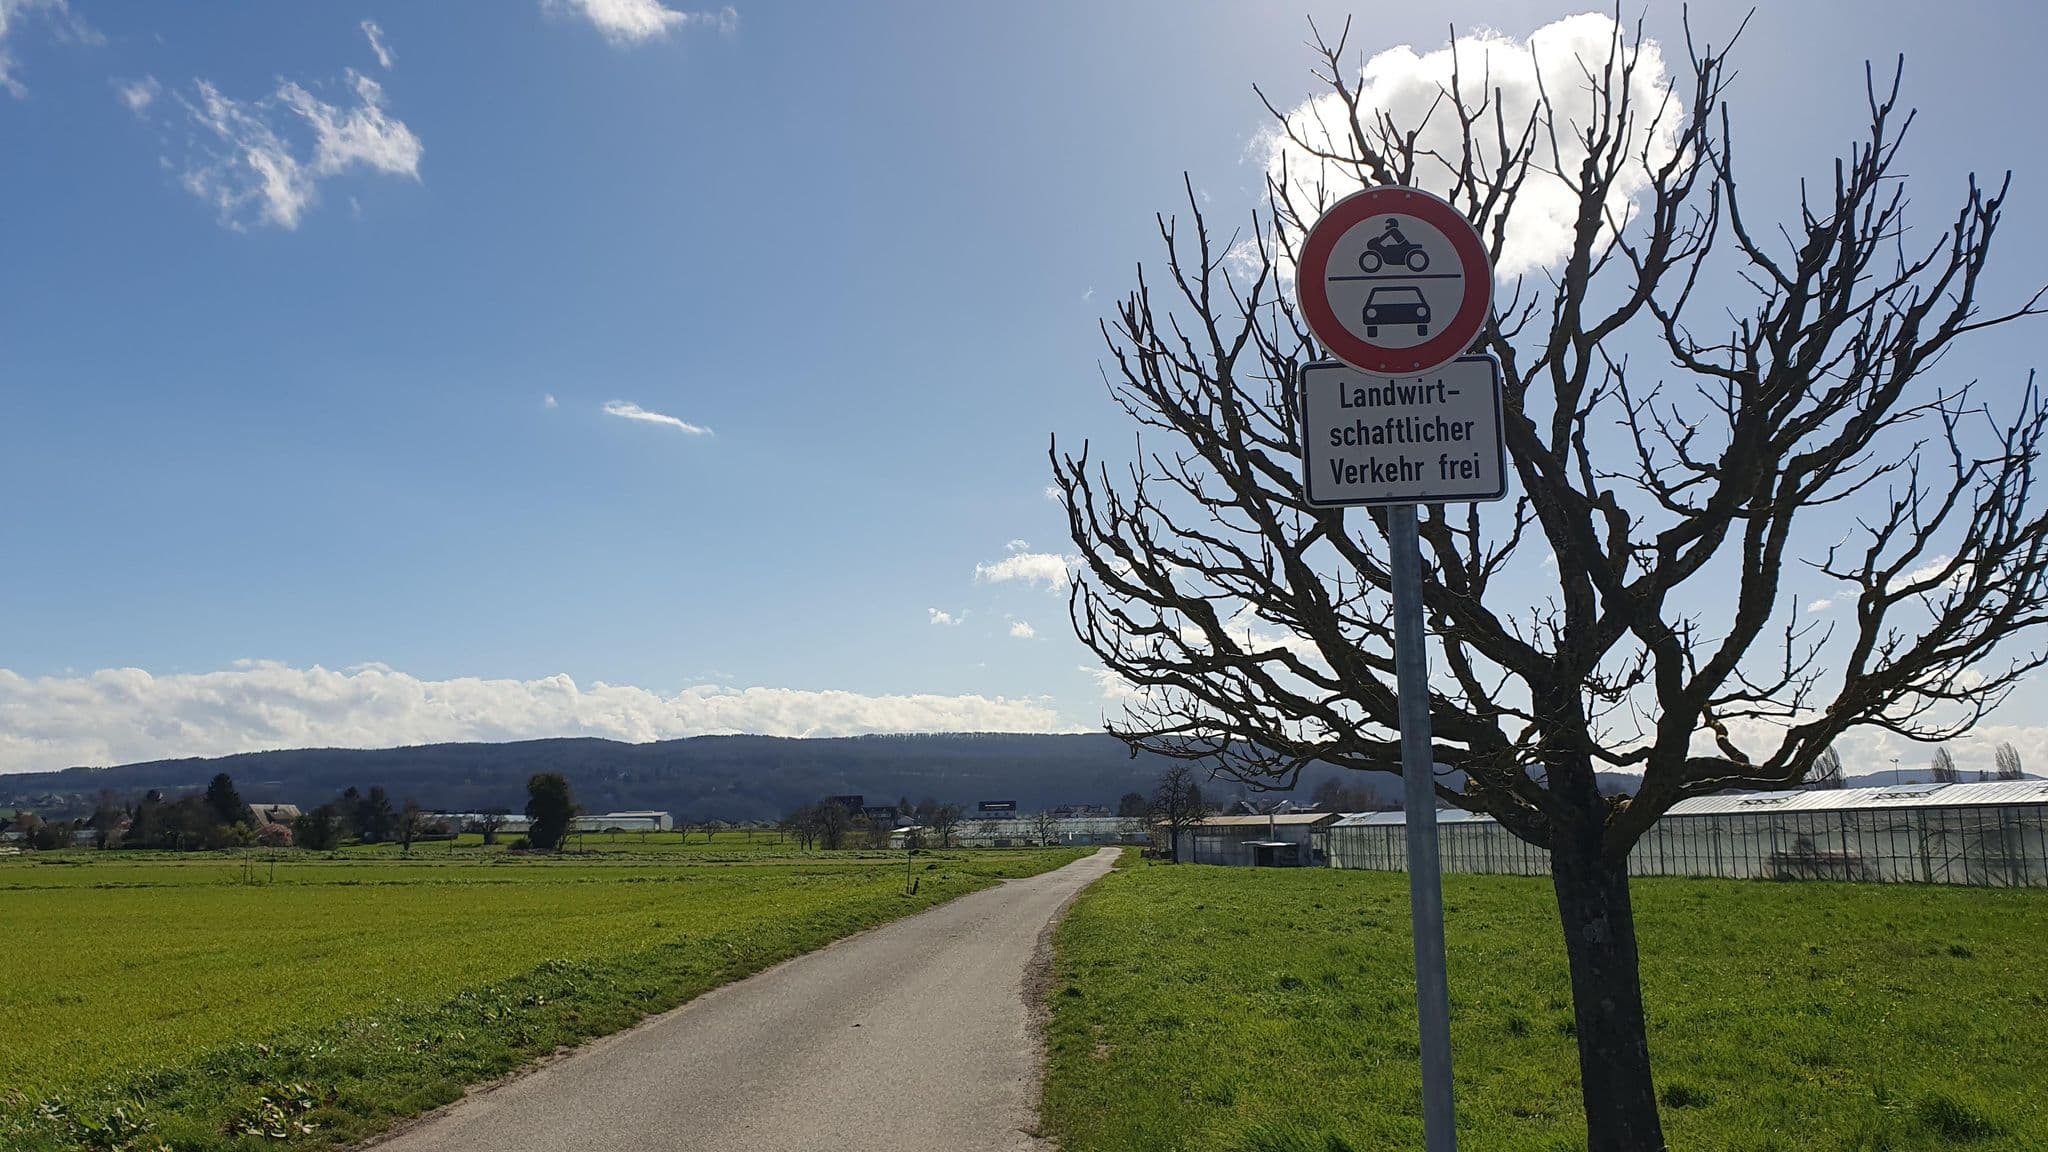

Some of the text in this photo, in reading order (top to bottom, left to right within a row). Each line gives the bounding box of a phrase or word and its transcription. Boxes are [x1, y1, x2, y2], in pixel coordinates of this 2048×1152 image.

[1339, 378, 1460, 409] Landwirt-
[1330, 416, 1475, 447] schaftlicher
[1330, 452, 1480, 485] Verkehr frei
